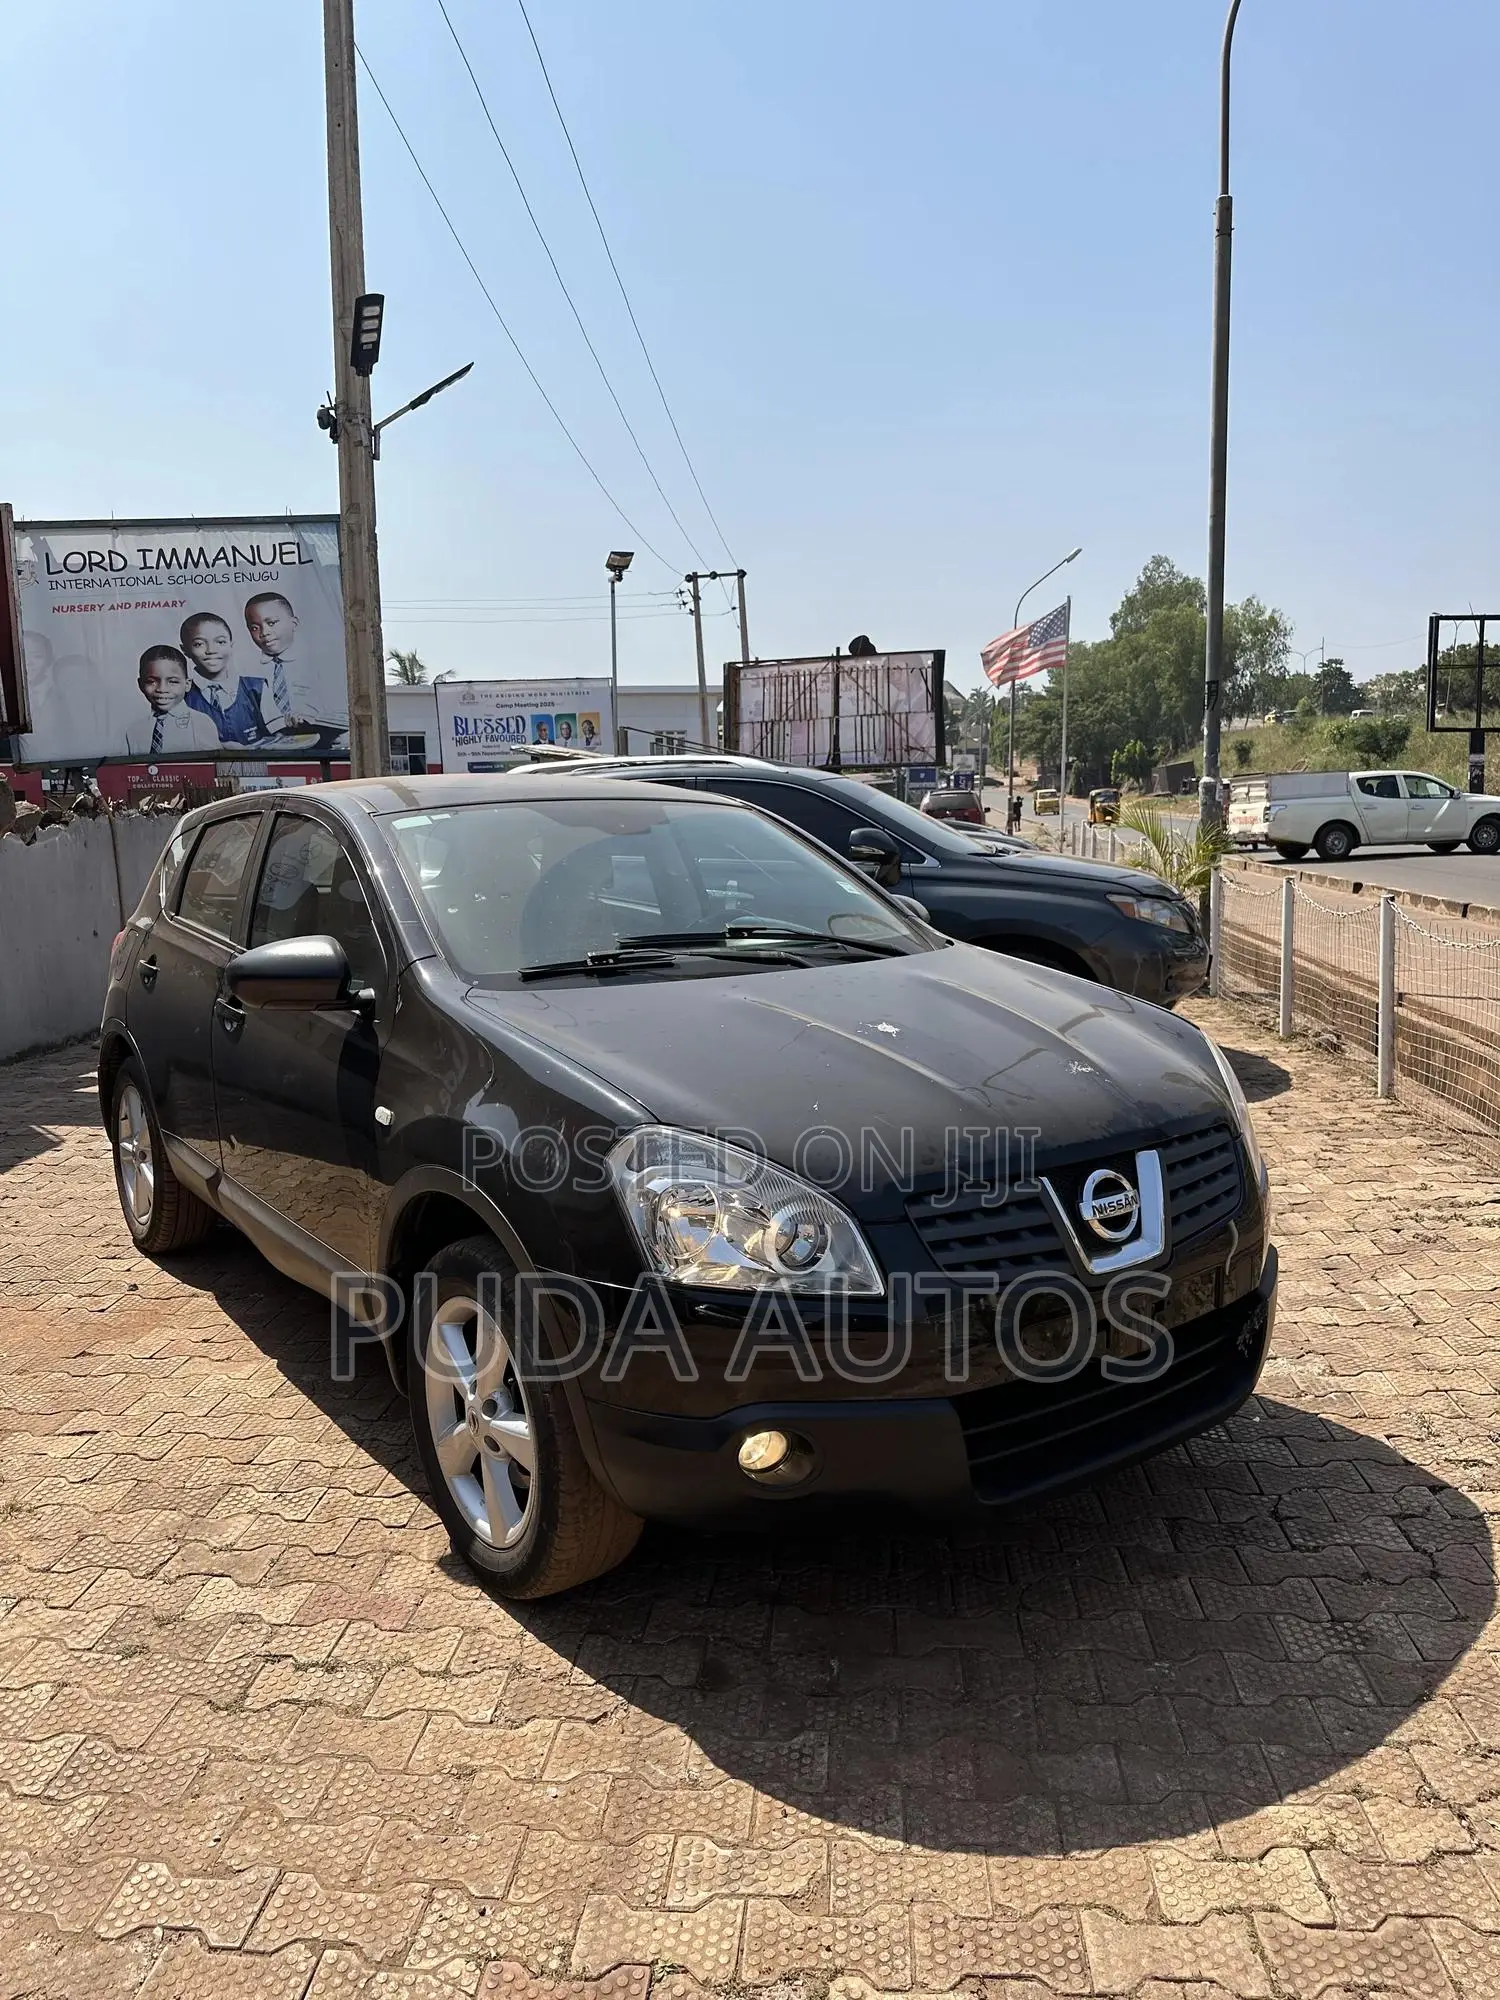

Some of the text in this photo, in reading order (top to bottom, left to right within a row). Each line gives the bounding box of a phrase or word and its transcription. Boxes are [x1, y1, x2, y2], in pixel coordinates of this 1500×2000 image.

[44, 541, 314, 576] LORD IMMANUEL
[47, 571, 280, 591] INTERNATIONAL SCHOOLS ENUGU
[52, 600, 187, 614] NURSERY AND PRIMARY
[453, 714, 526, 737] BLESSED
[455, 735, 482, 747] HIGHLY
[485, 734, 527, 744] FAVOURED
[1091, 1193, 1139, 1218] NISSAN
